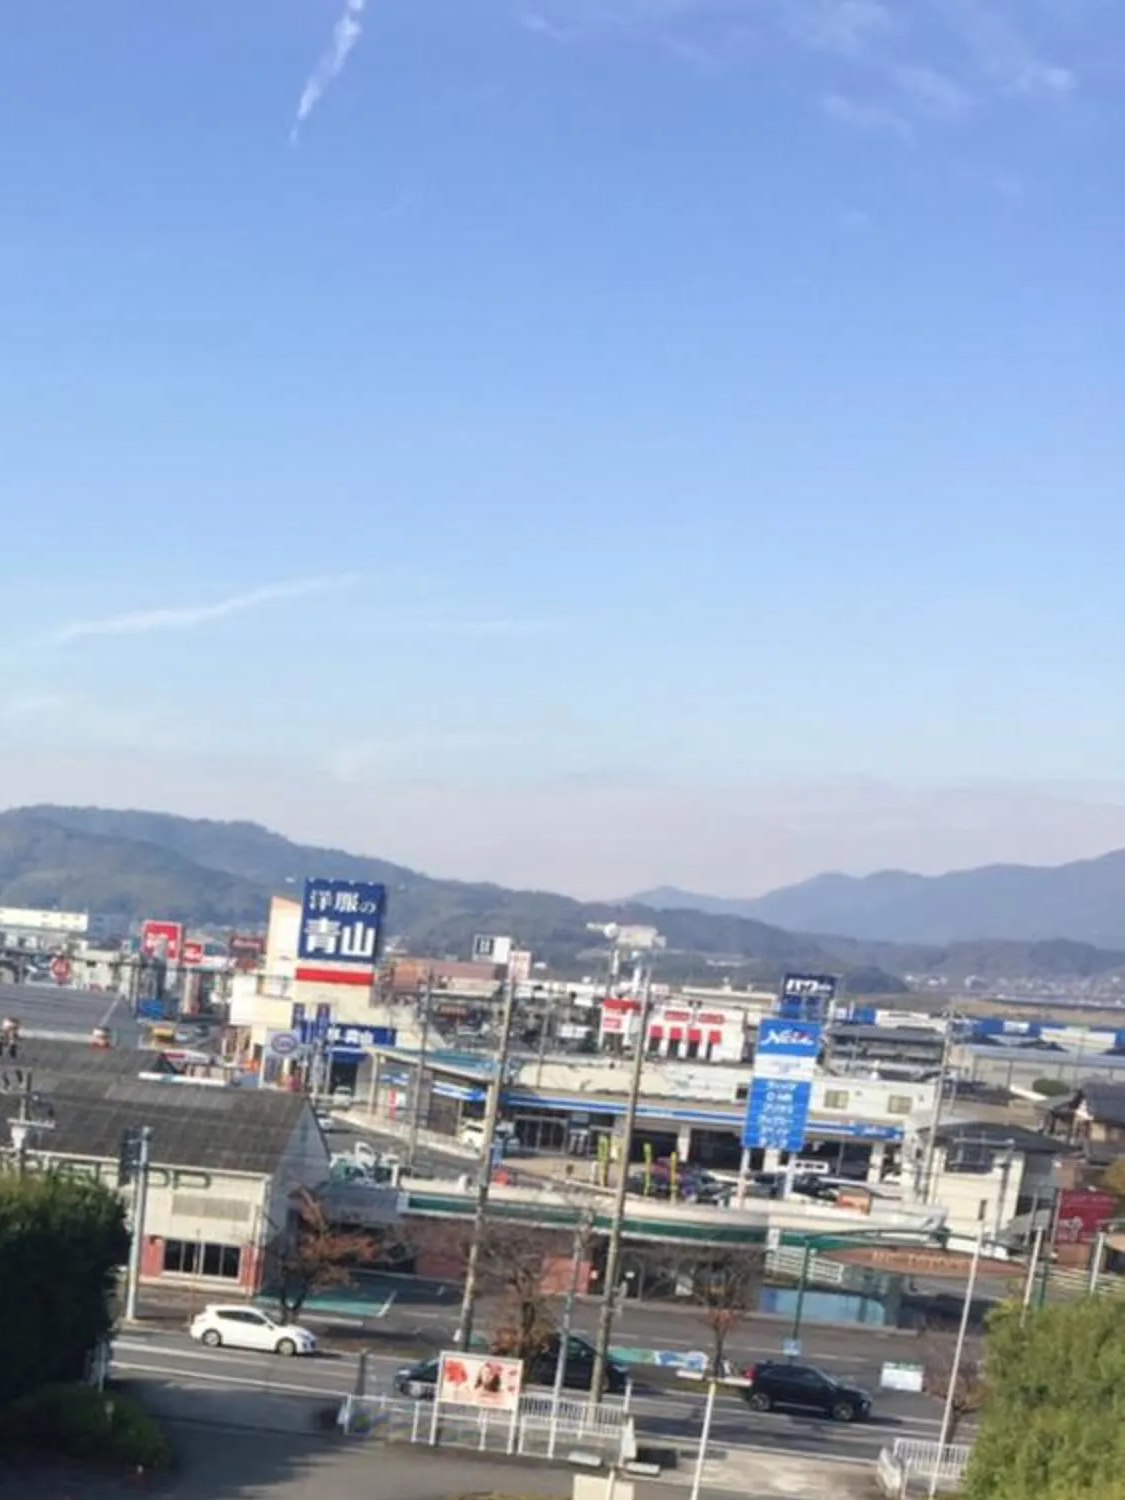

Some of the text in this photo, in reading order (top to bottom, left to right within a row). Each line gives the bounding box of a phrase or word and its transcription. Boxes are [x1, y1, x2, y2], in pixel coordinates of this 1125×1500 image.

[309, 889, 376, 913] 洋服の
[305, 917, 375, 957] 青山
